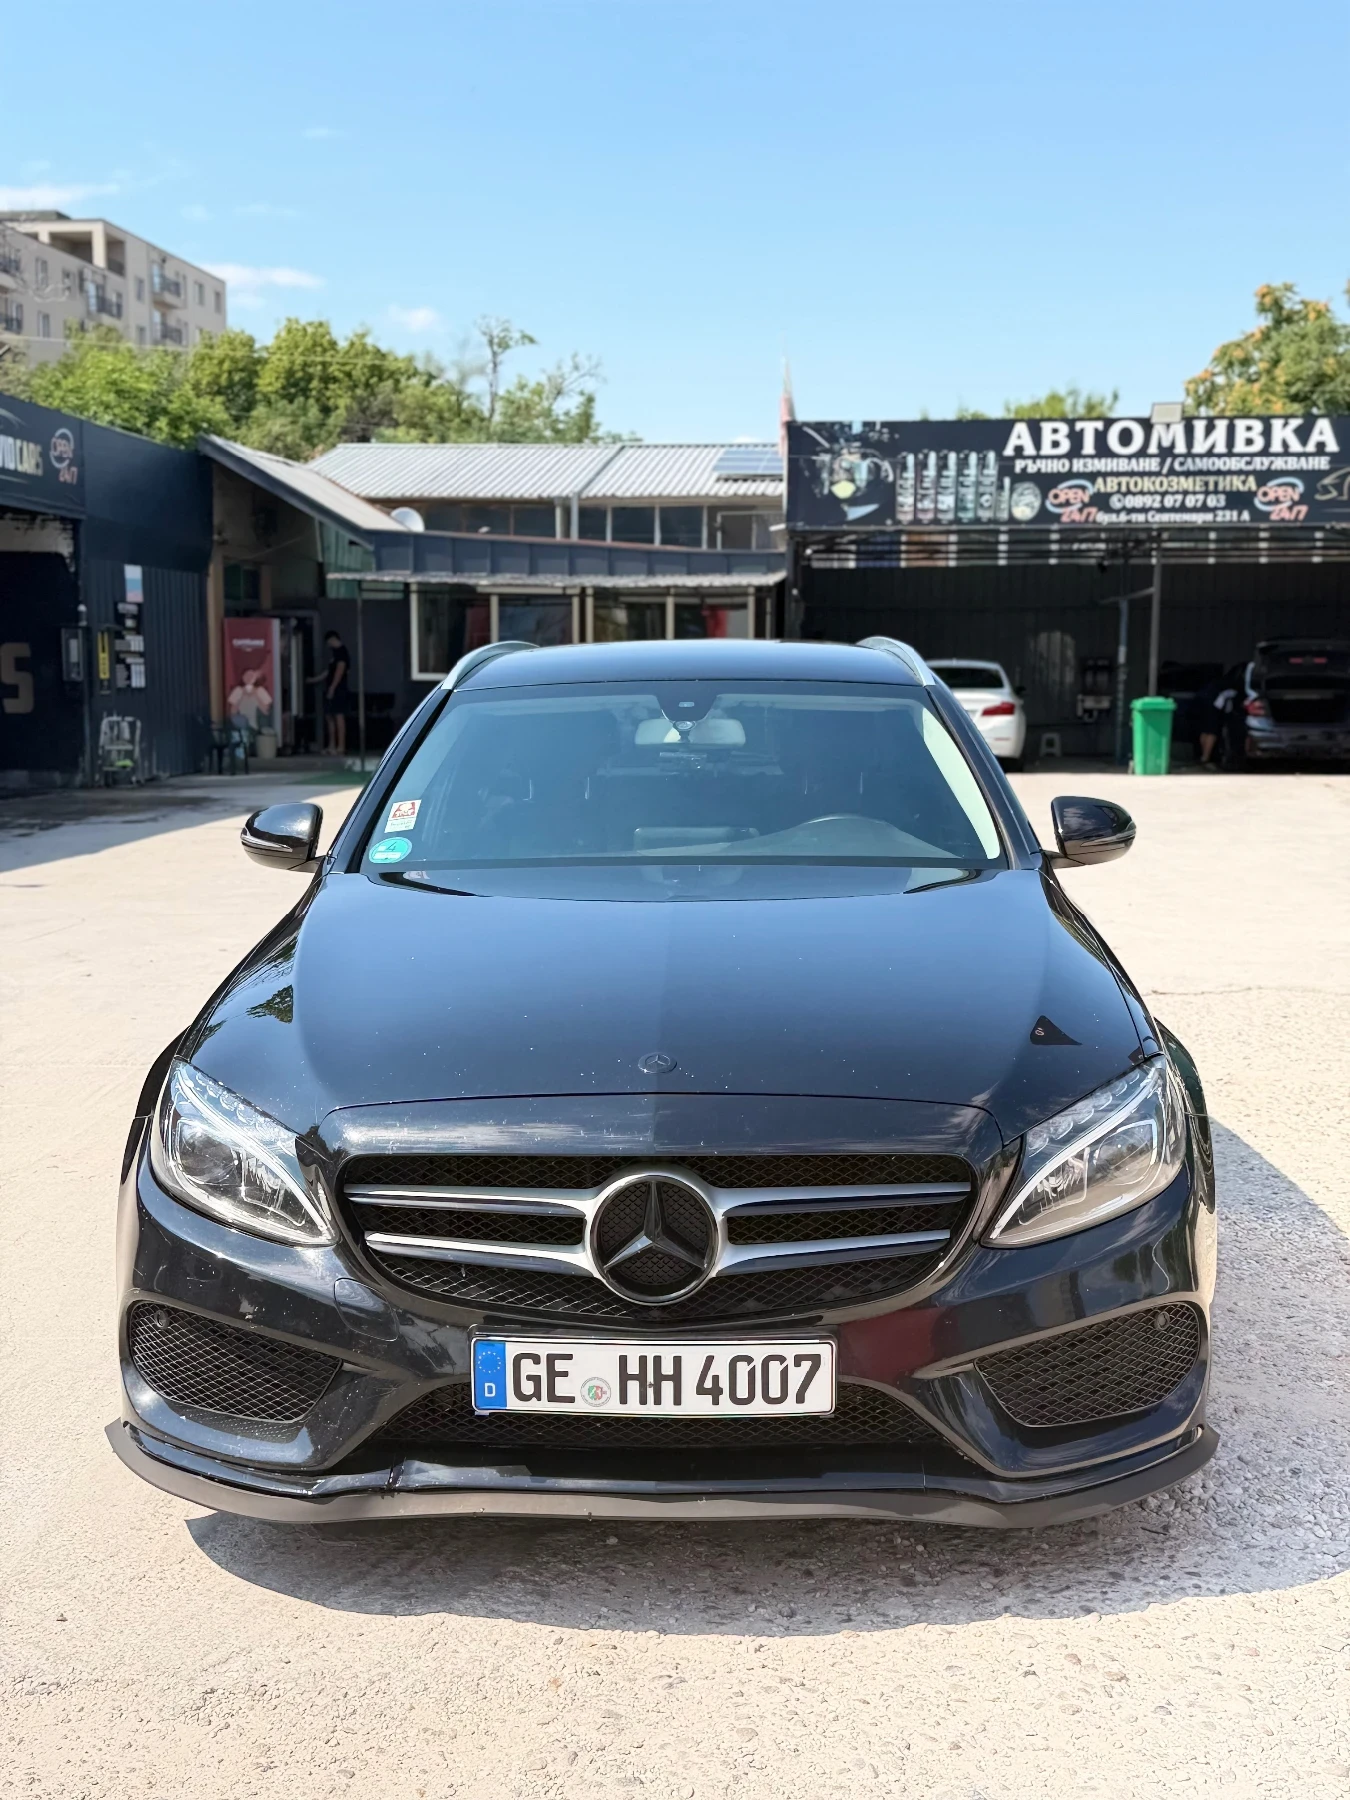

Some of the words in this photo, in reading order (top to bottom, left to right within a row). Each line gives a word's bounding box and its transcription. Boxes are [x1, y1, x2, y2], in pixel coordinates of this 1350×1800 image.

[1002, 418, 1340, 457] АВТОМИВКА
[1014, 458, 1070, 474] РЪЧНО
[1072, 457, 1160, 473] ИЗМИВАНЕ
[1173, 456, 1331, 472] САМООБСЛУЖВАНЕ
[1094, 475, 1257, 493] АВТОКОЗМЕТИКА
[1048, 488, 1090, 504] OPEN
[1163, 494, 1184, 508] 07
[1185, 493, 1205, 508] 07
[1257, 486, 1301, 502] OPEN
[1060, 506, 1098, 523] 24/7
[1269, 504, 1309, 521] 24/7
[484, 1383, 496, 1398] D
[512, 1352, 575, 1404] GE
[619, 1354, 682, 1406] HH
[696, 1354, 822, 1406] 4007
